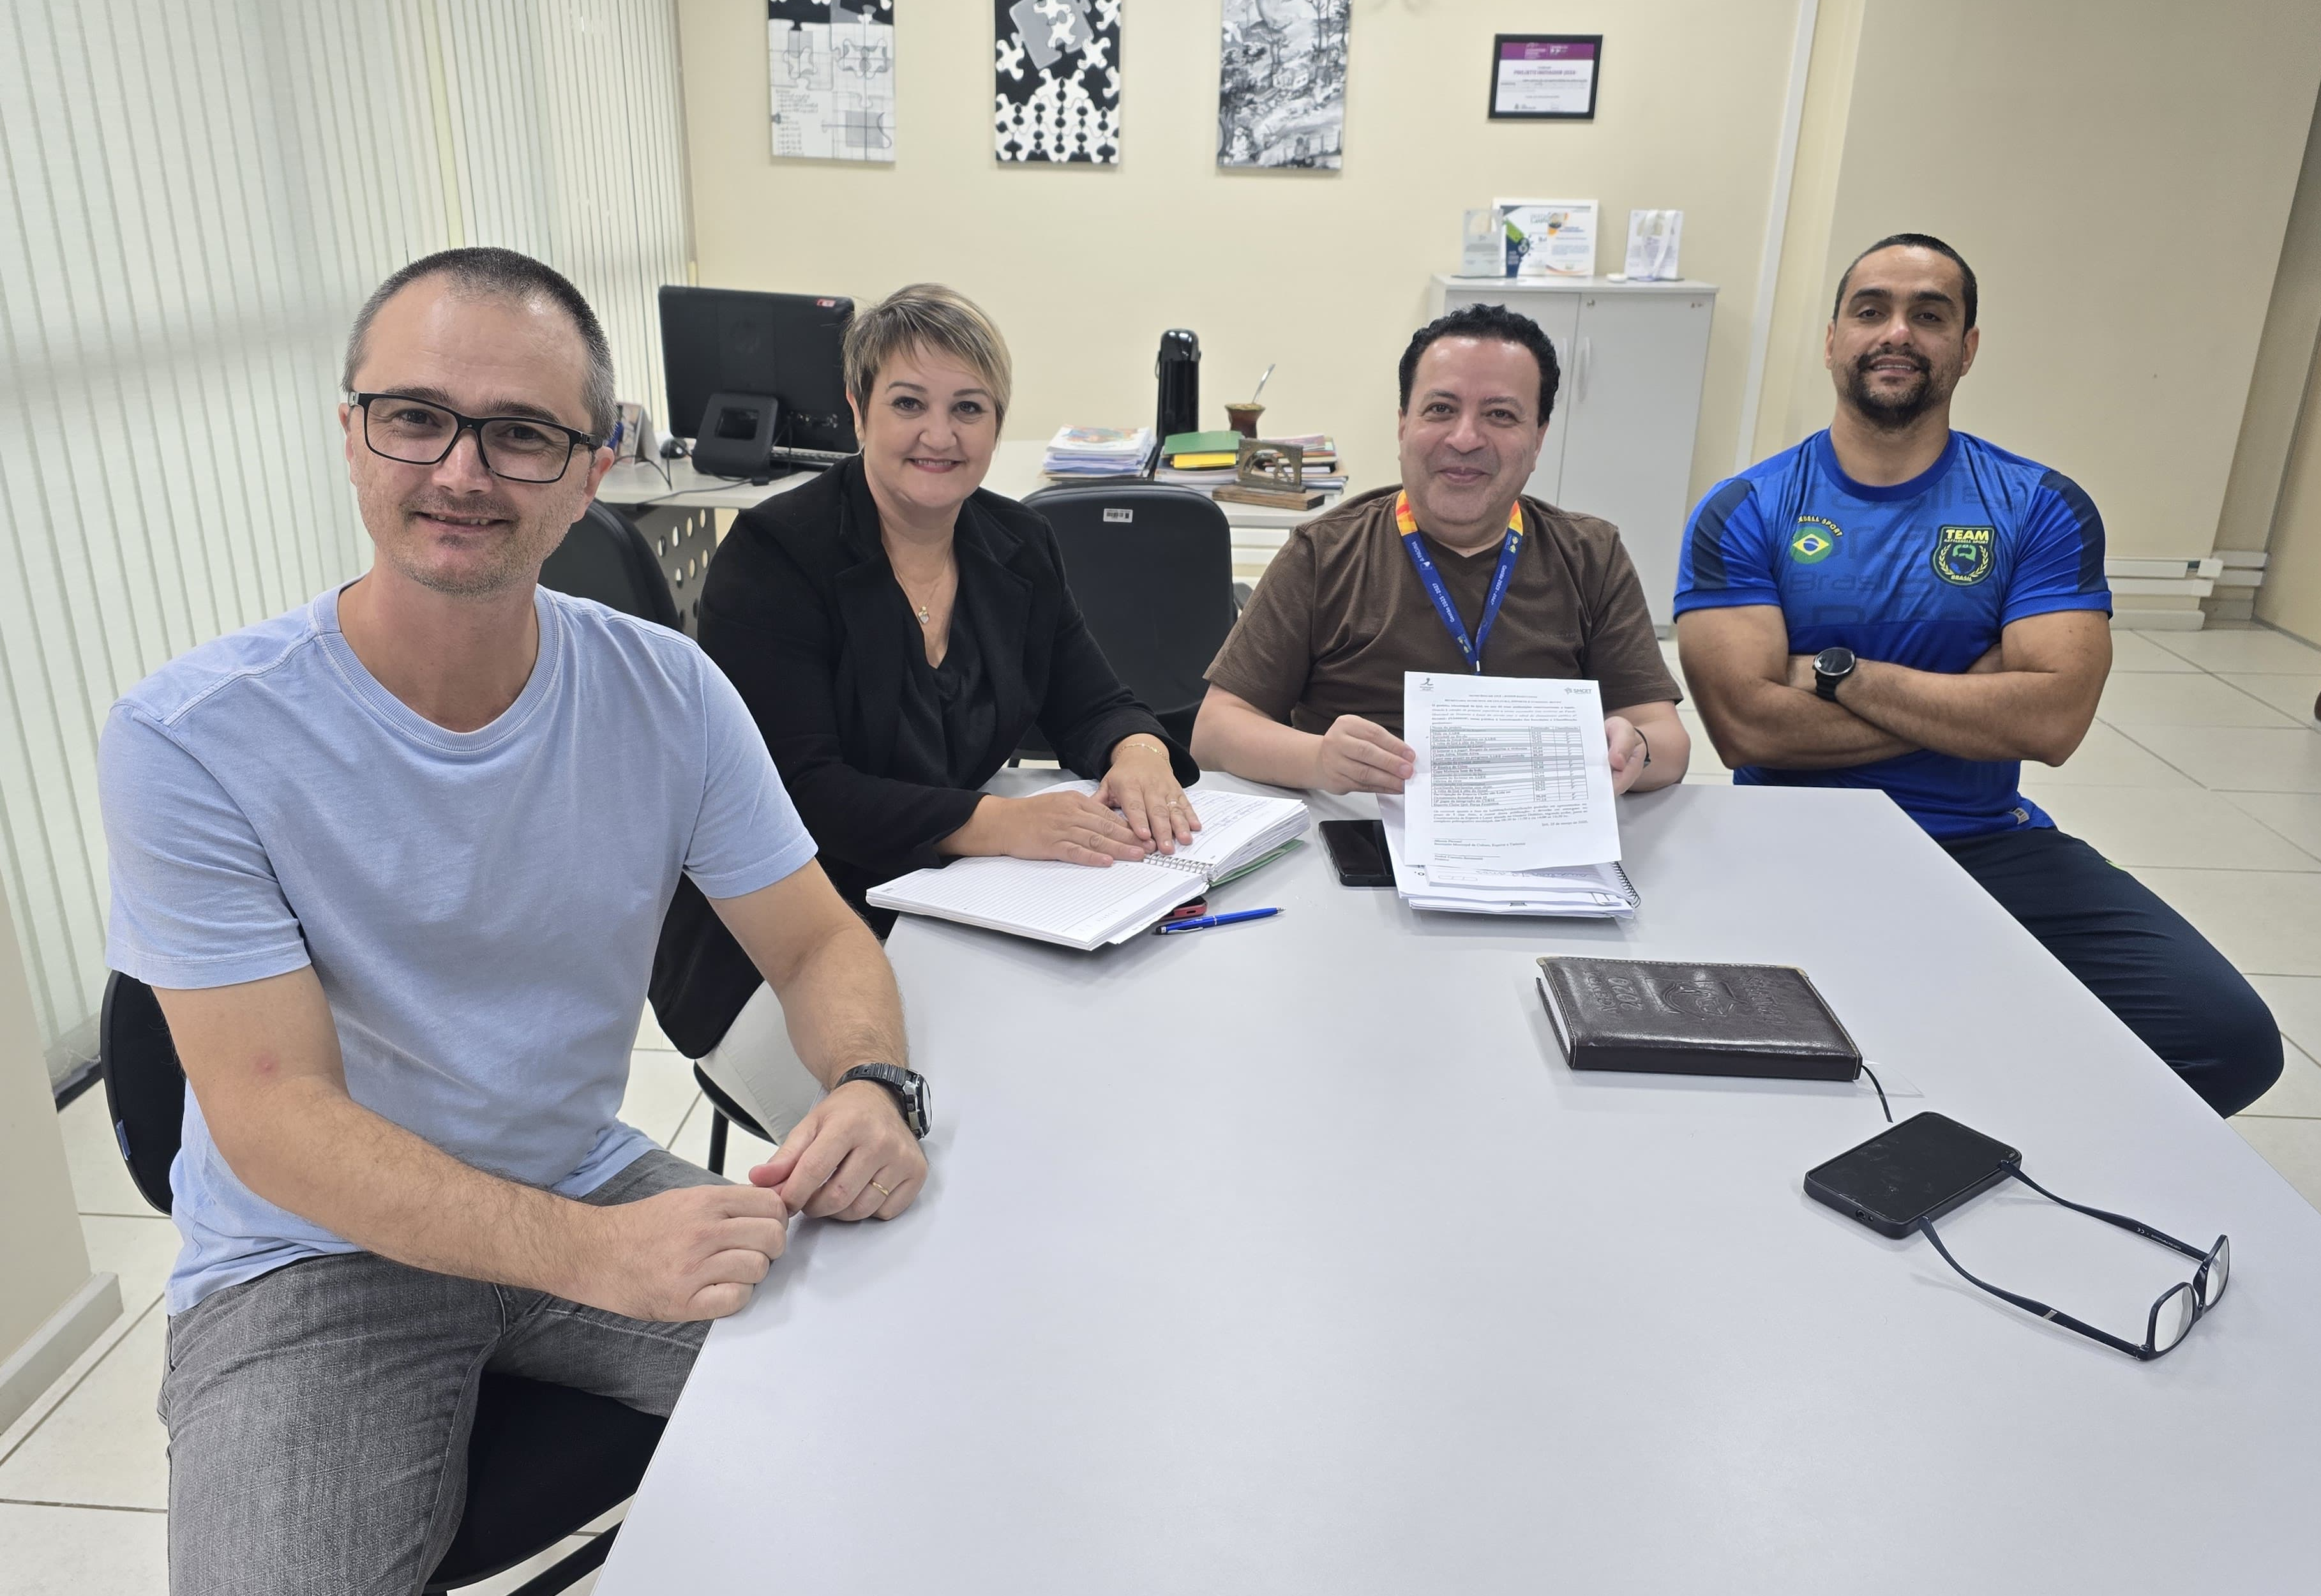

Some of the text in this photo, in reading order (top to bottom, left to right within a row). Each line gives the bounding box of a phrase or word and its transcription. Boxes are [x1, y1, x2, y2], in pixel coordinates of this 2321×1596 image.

[1821, 518, 1843, 536] SPORT
[1945, 529, 1989, 541] TEAM
[1446, 607, 1455, 622] Gestão
[1608, 976, 1642, 1011] 2020
